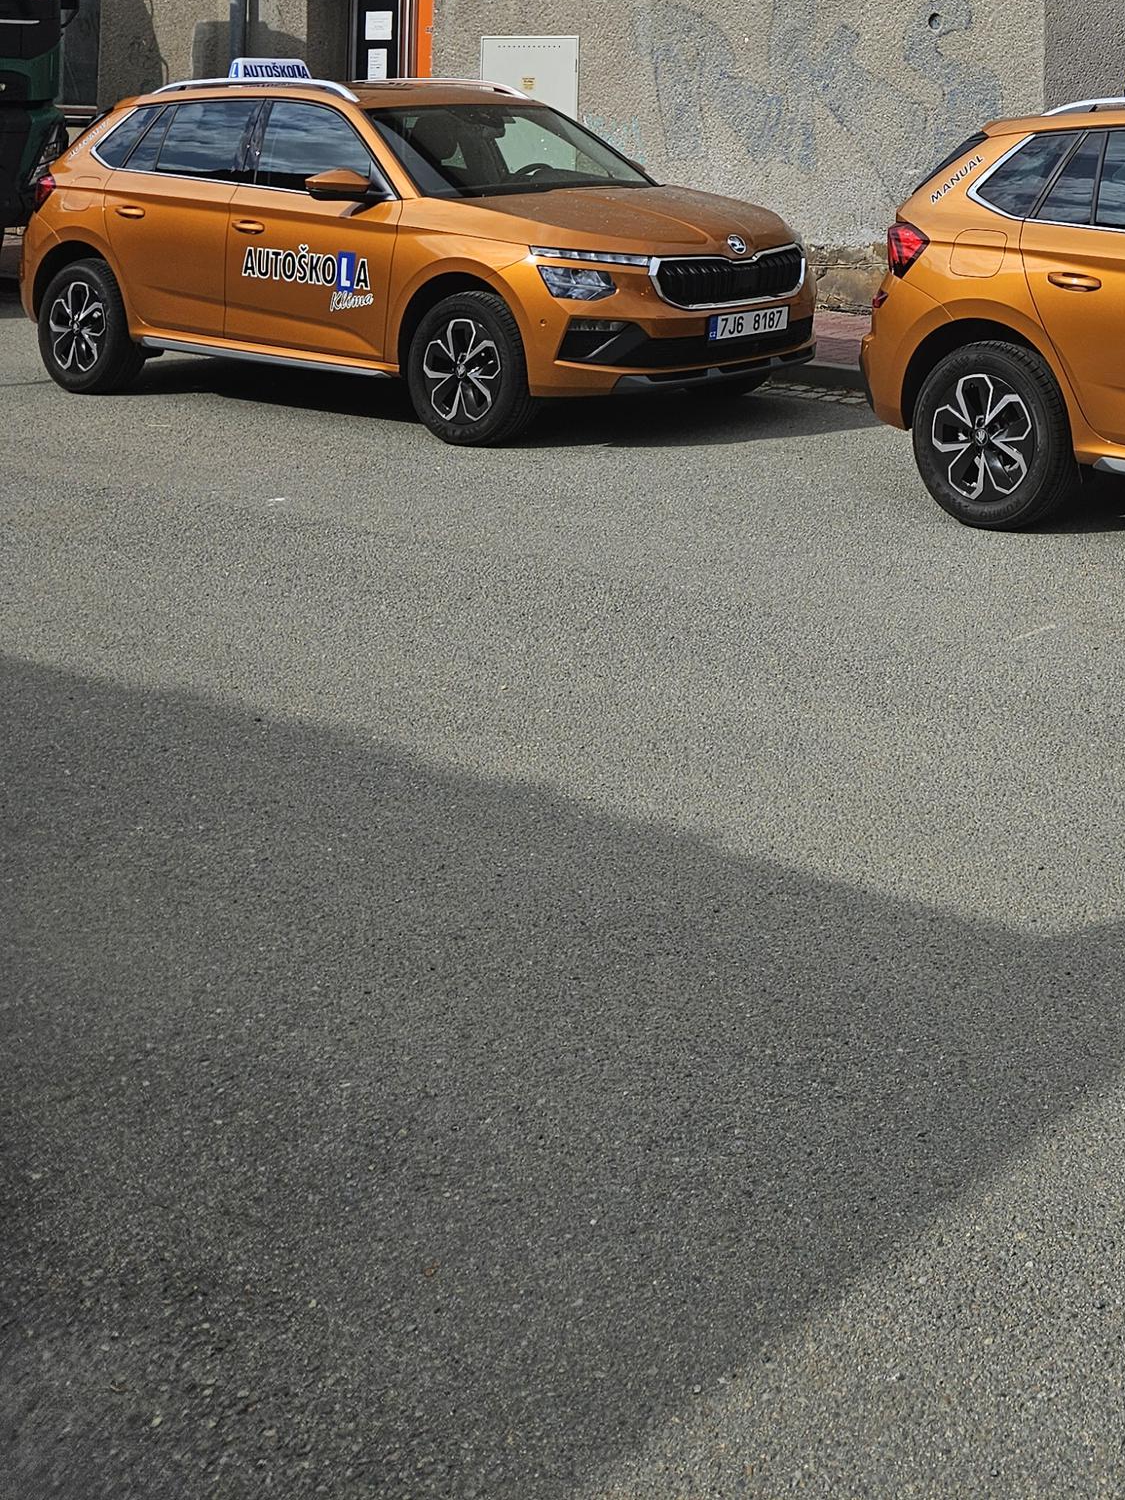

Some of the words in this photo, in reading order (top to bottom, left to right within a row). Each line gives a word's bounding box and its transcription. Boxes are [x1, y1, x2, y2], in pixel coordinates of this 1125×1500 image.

[243, 62, 310, 79] AUTOŠKOLA
[930, 155, 984, 204] MANUAL
[242, 244, 370, 290] AUTOŠKOLA
[330, 290, 374, 311] Klima
[720, 316, 744, 336] 7J6
[753, 310, 783, 331] 8187
